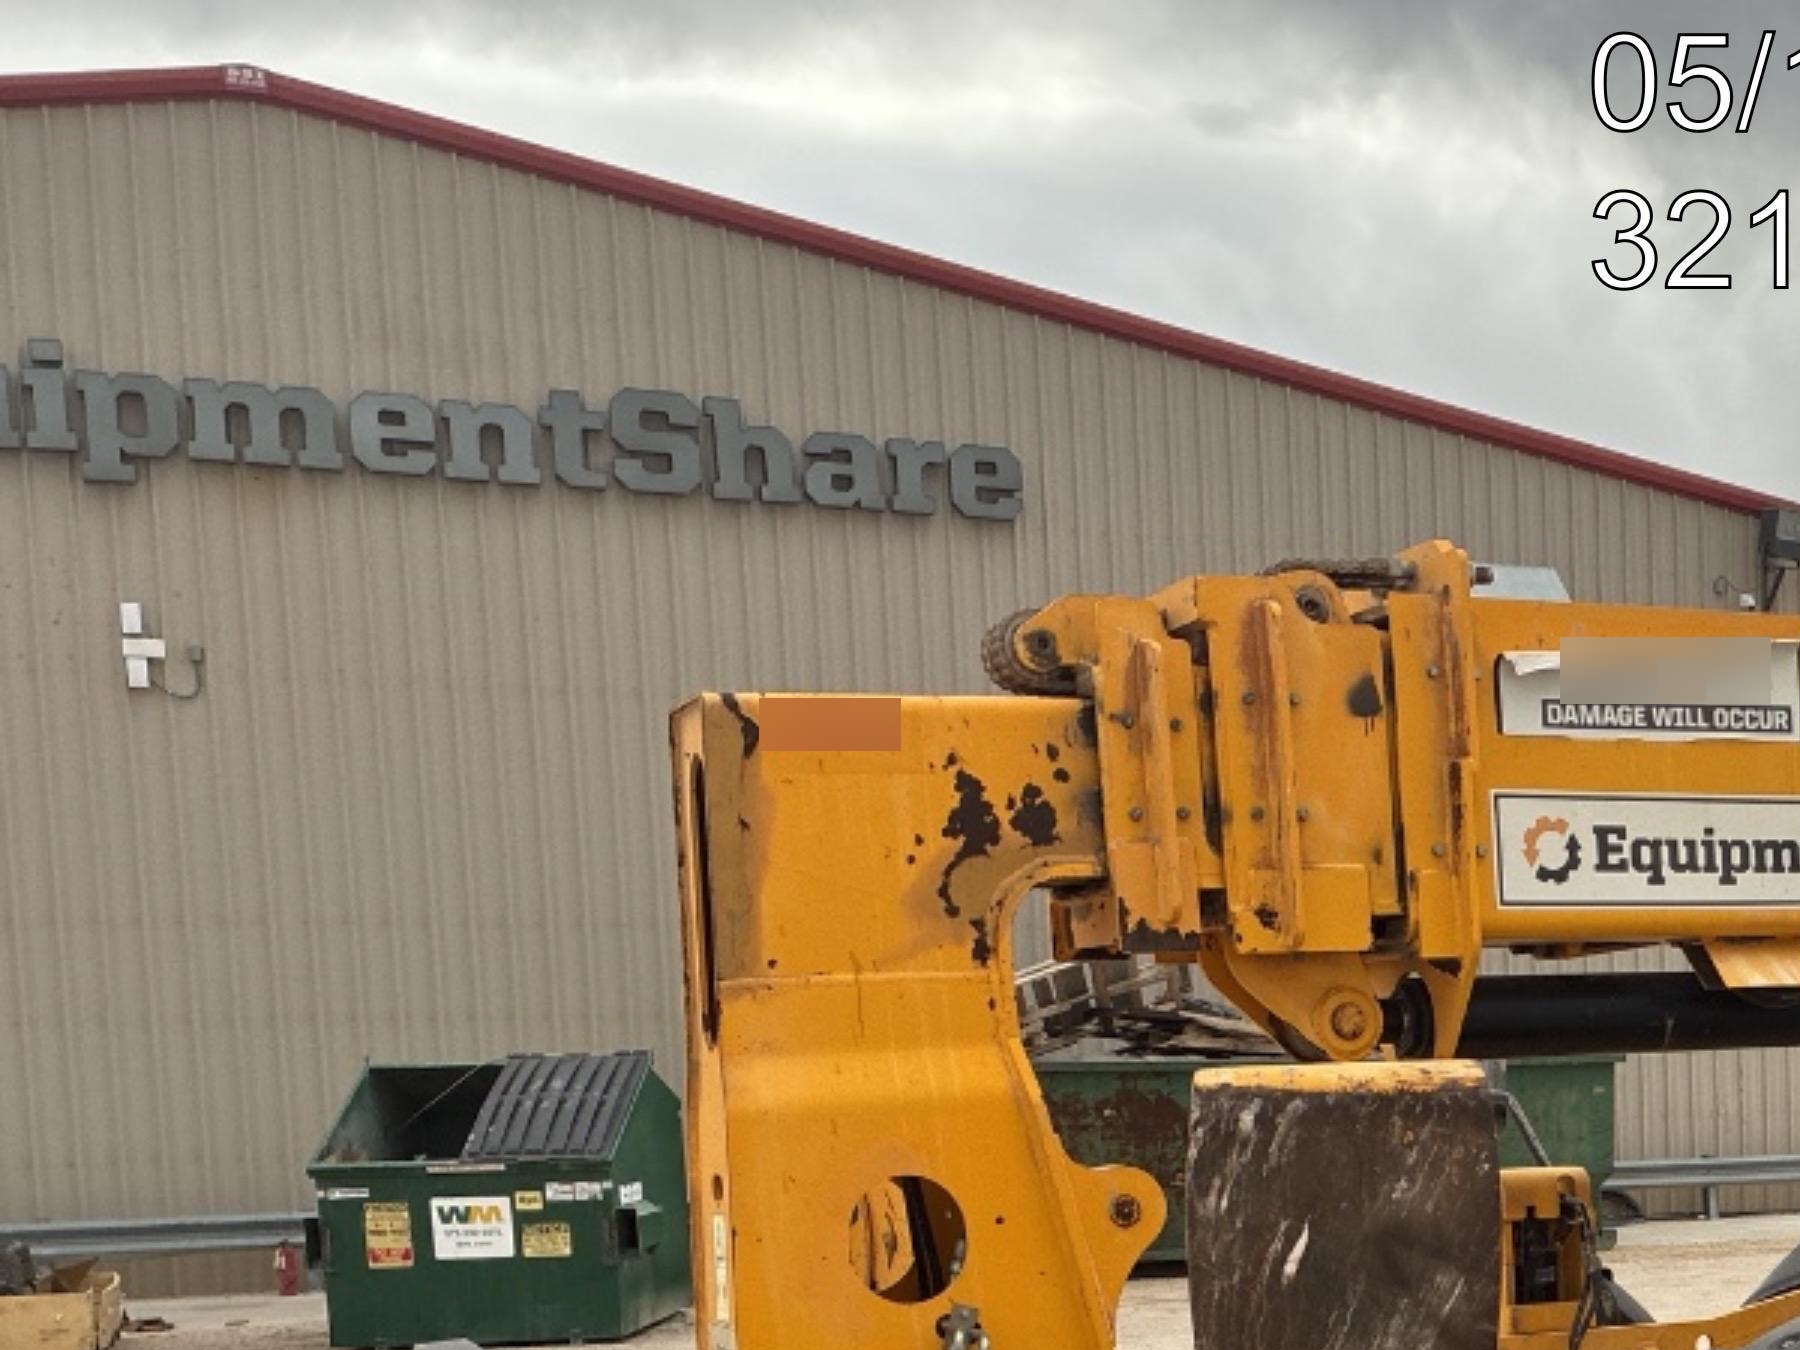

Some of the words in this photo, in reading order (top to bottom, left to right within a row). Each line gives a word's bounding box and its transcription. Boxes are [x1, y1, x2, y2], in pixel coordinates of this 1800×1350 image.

[0, 339, 1023, 522] ipmentShare
[1546, 703, 1648, 727] DAMAGE
[1652, 706, 1709, 729] WILL
[1712, 706, 1789, 731] OCCUR
